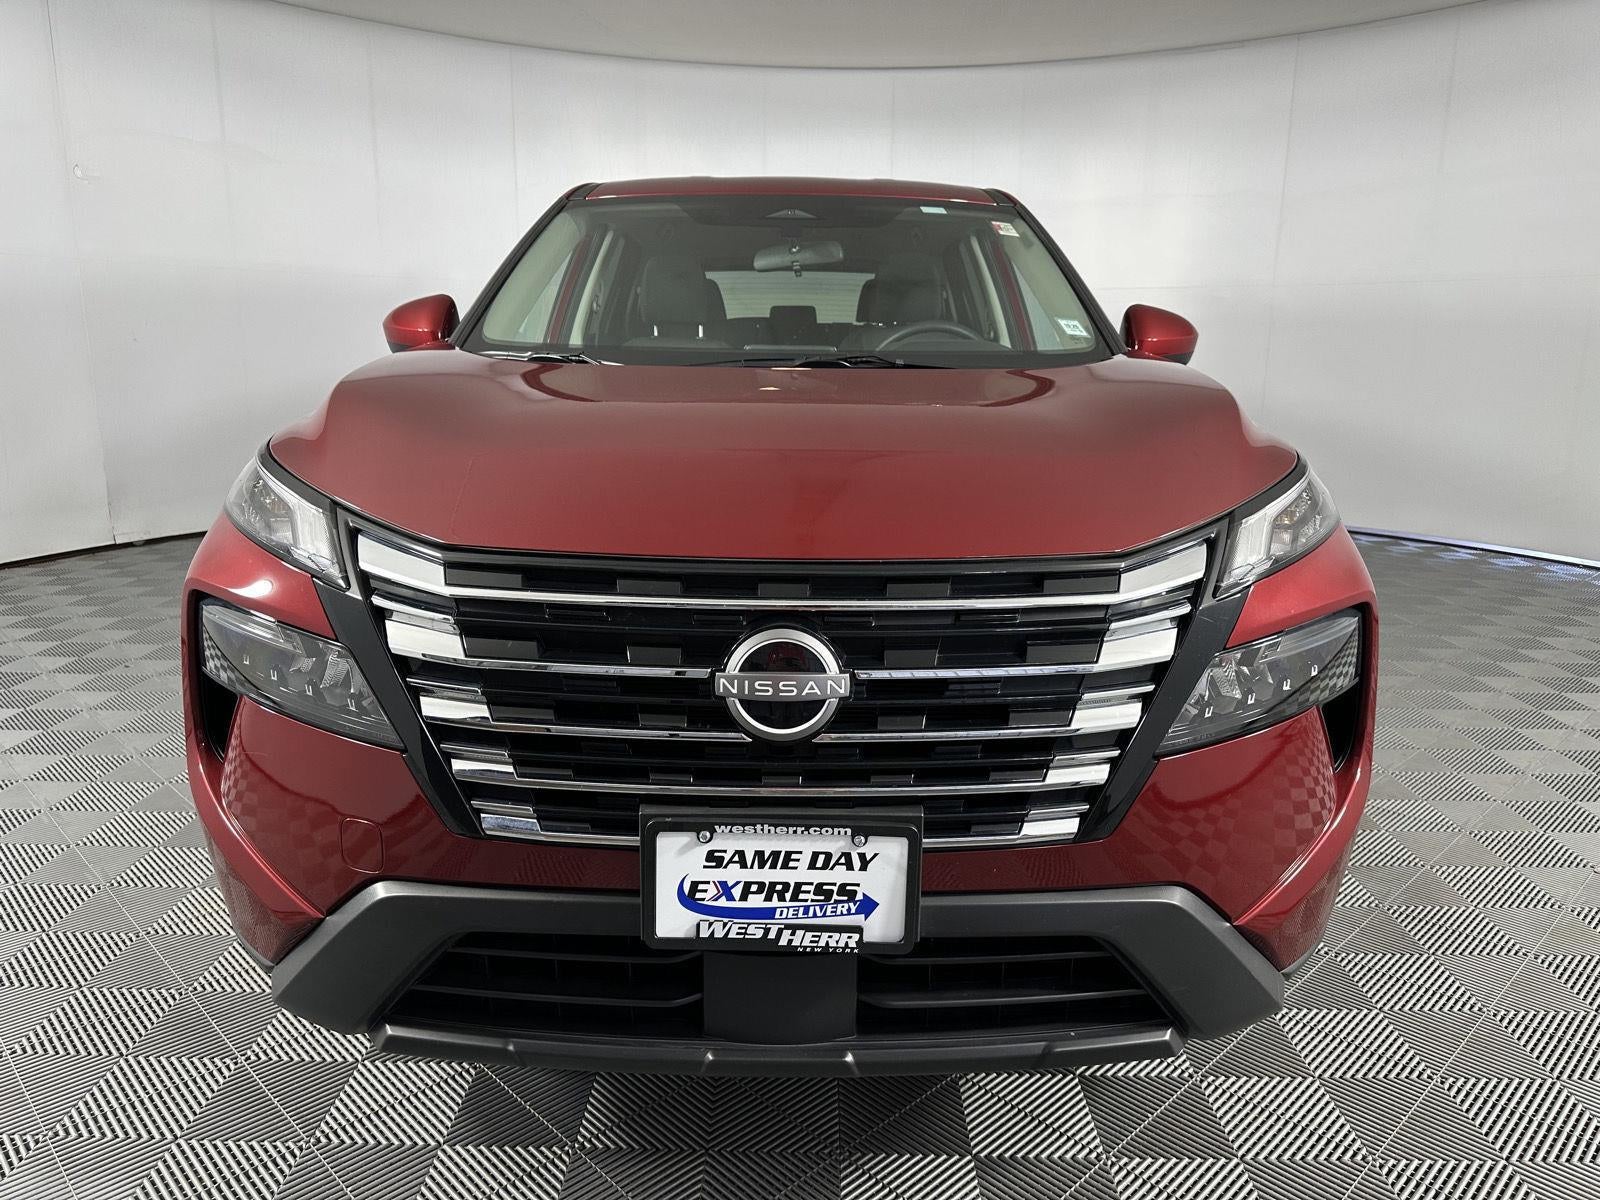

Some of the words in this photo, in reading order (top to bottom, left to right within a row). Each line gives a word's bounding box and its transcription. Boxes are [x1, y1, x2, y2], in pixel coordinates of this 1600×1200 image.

[719, 677, 845, 696] NISSAN
[714, 824, 852, 836] westherr.com
[703, 849, 803, 870] SAME
[807, 851, 880, 872] DAY
[687, 880, 861, 903] EXPRESS
[774, 902, 860, 919] DELIVERY
